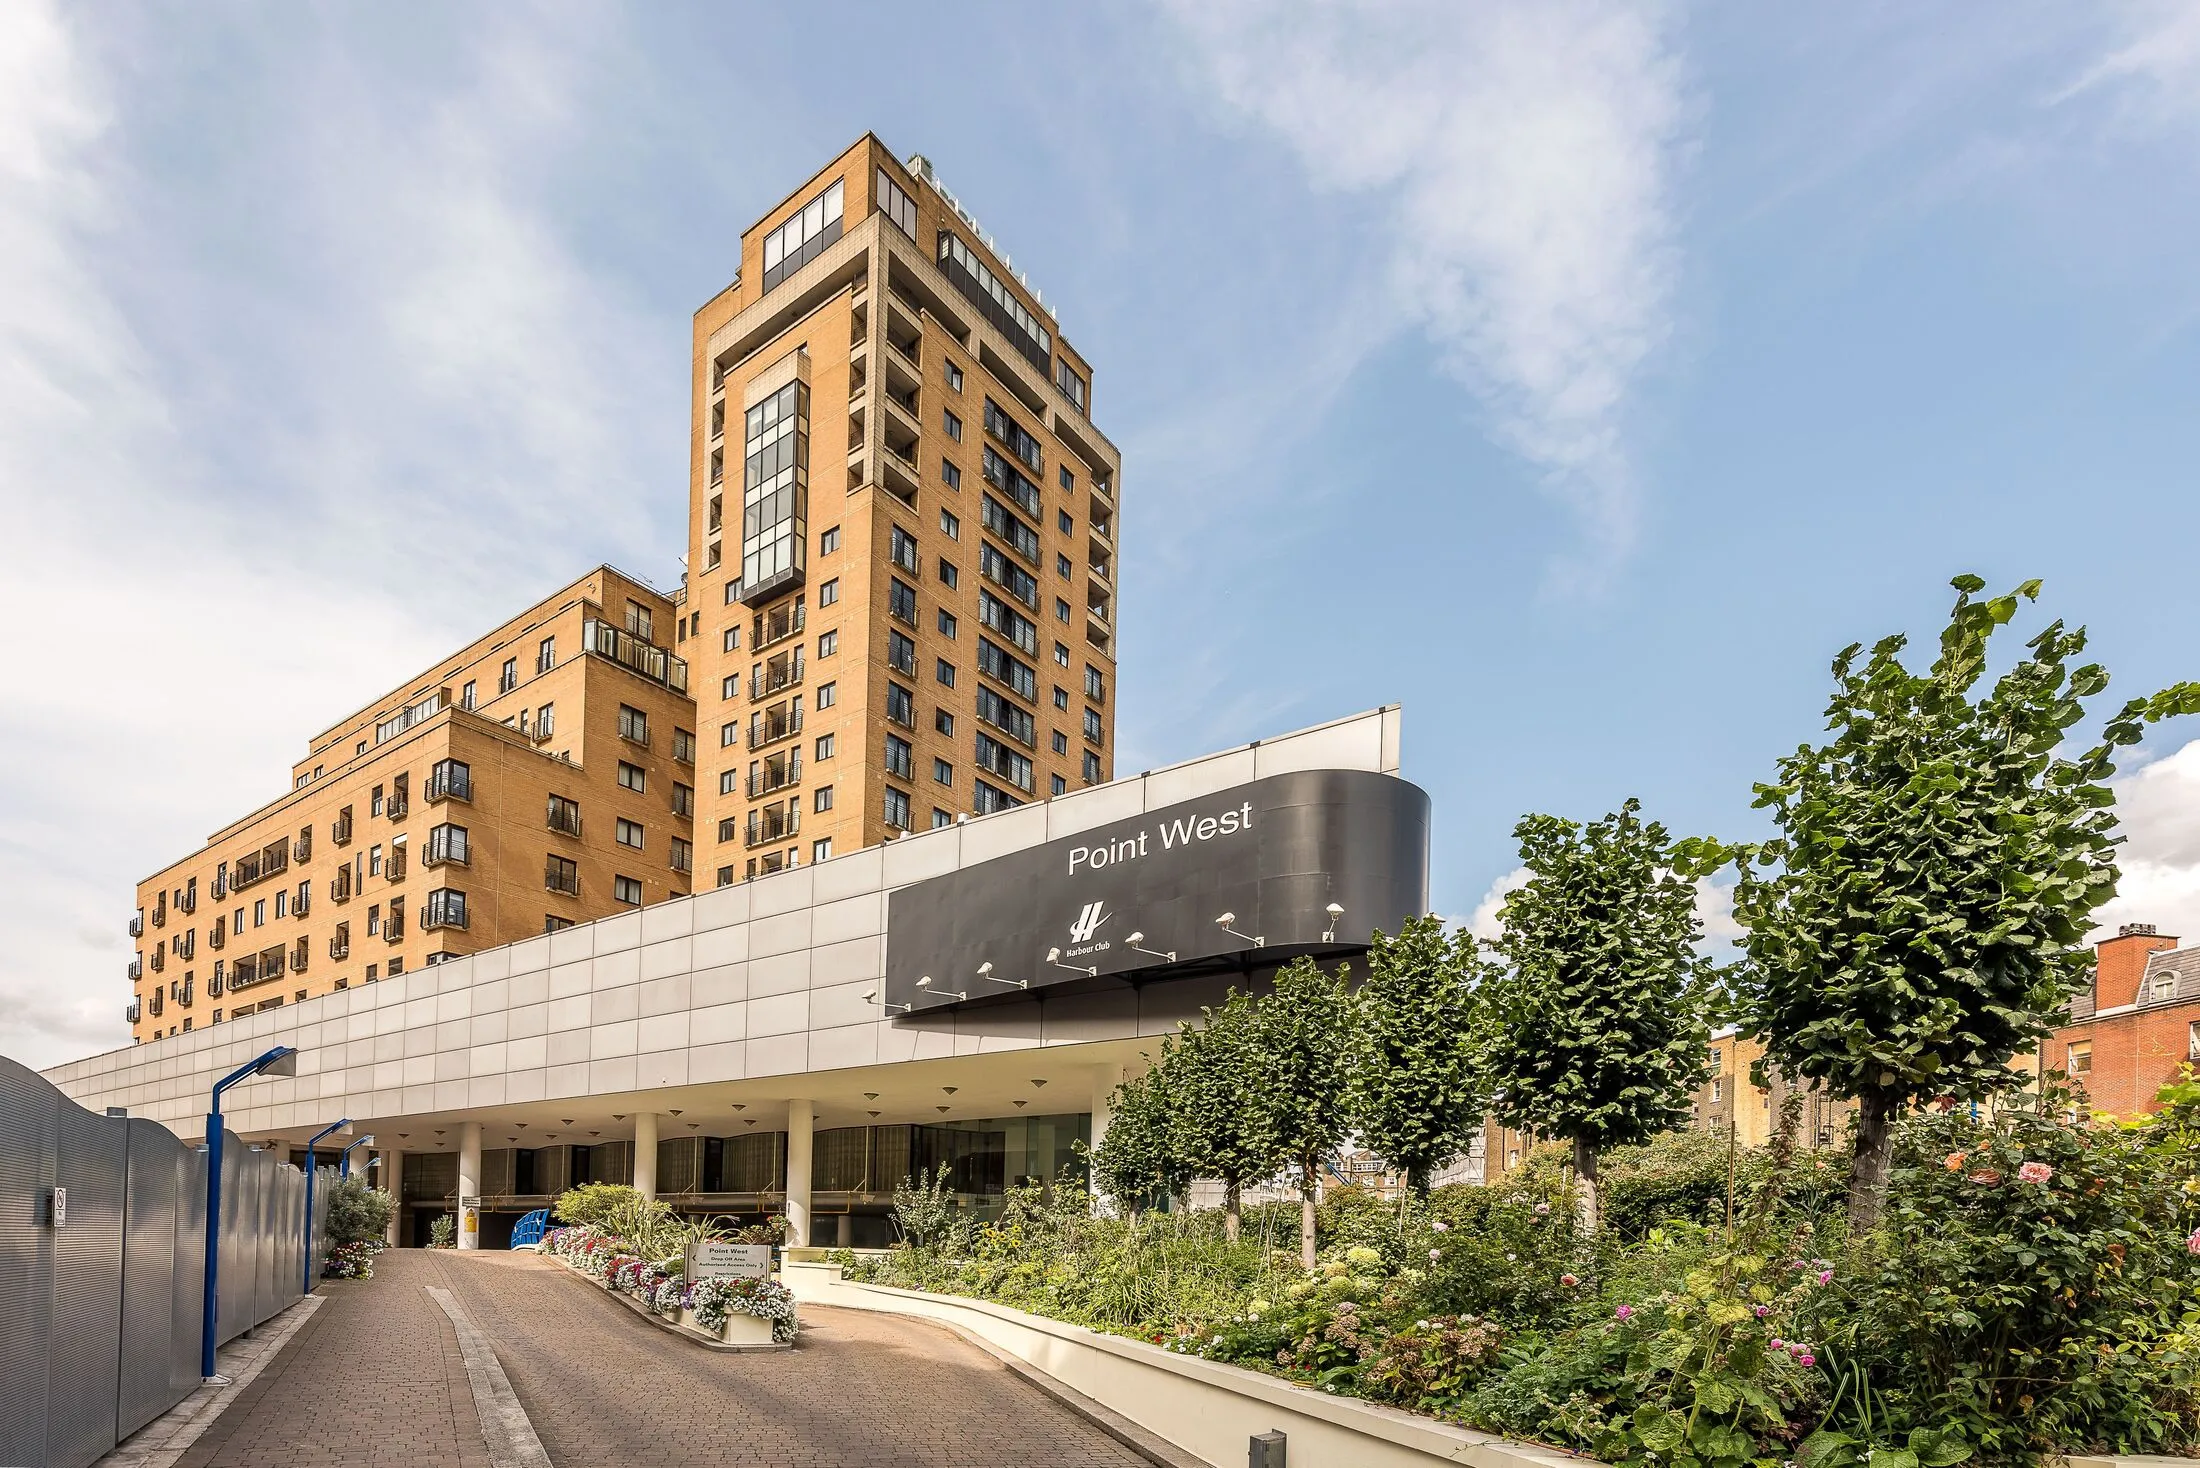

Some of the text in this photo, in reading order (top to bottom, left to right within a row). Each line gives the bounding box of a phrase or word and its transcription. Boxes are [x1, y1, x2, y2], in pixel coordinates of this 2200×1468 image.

[1068, 801, 1253, 876] Point West
[1066, 941, 1111, 958] Harbour Club
